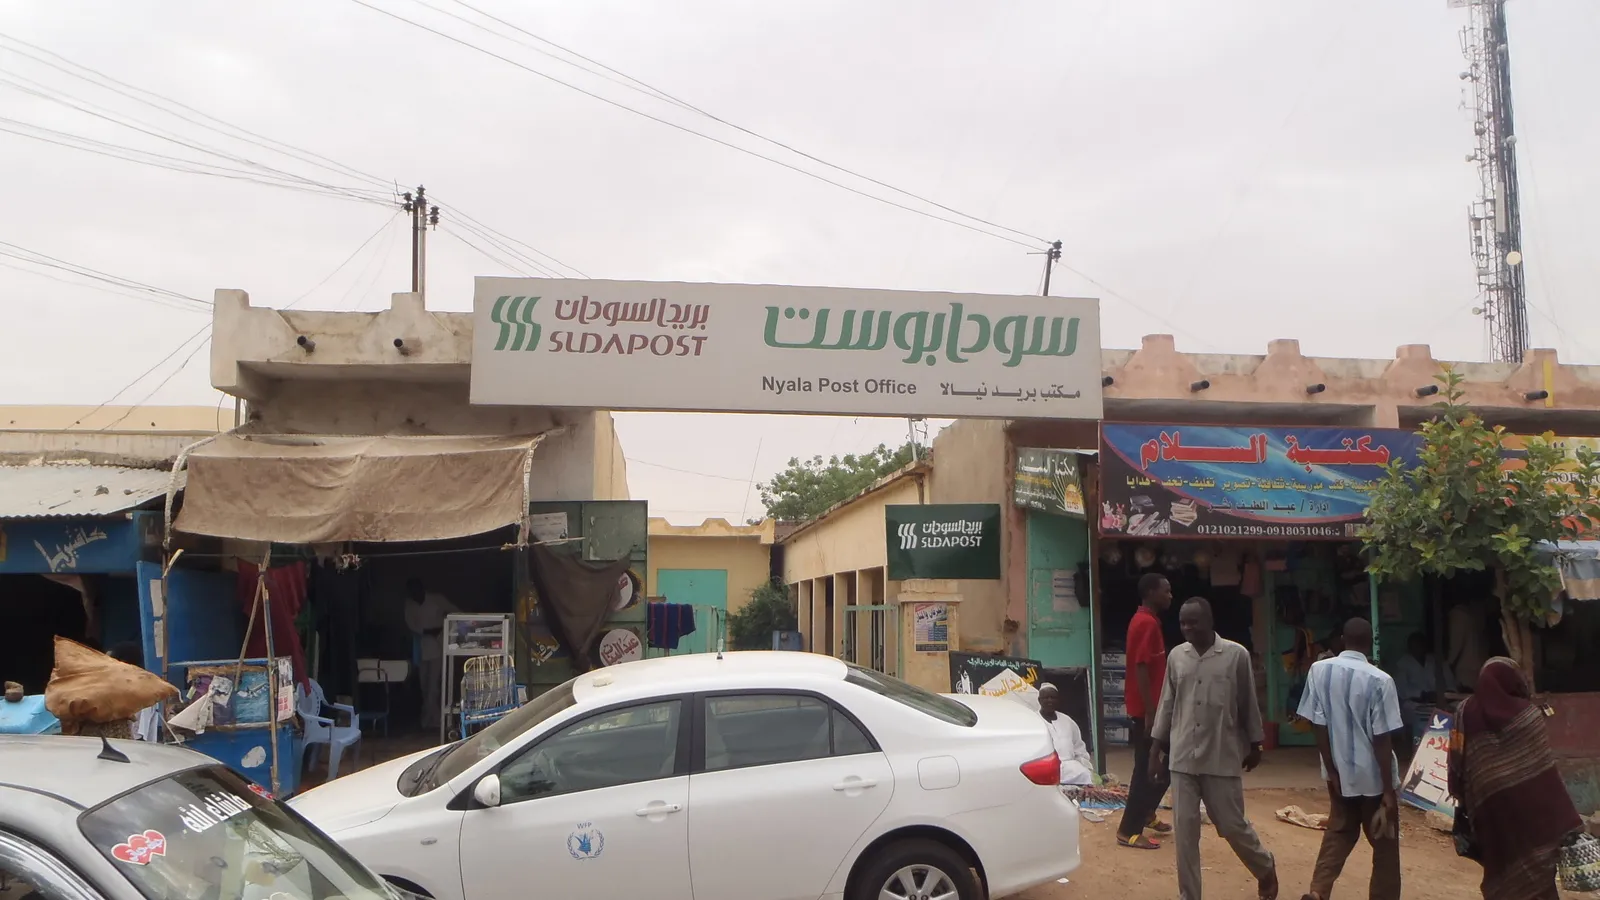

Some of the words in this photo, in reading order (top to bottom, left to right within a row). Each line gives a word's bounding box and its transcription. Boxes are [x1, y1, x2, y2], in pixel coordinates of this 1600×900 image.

[548, 330, 708, 356] SUDAPOST
[762, 376, 812, 395] Nyala
[818, 378, 859, 394] Post
[864, 378, 917, 395] Office
[992, 382, 1037, 402] بريد
[1040, 383, 1081, 400] مكتب
[1140, 431, 1268, 470] السلام
[1285, 432, 1391, 472] مكتبة
[1236, 498, 1269, 514] اللطيف
[1272, 502, 1296, 514] عبد
[920, 535, 983, 548] SUDAPOST
[576, 821, 592, 829] WFP
